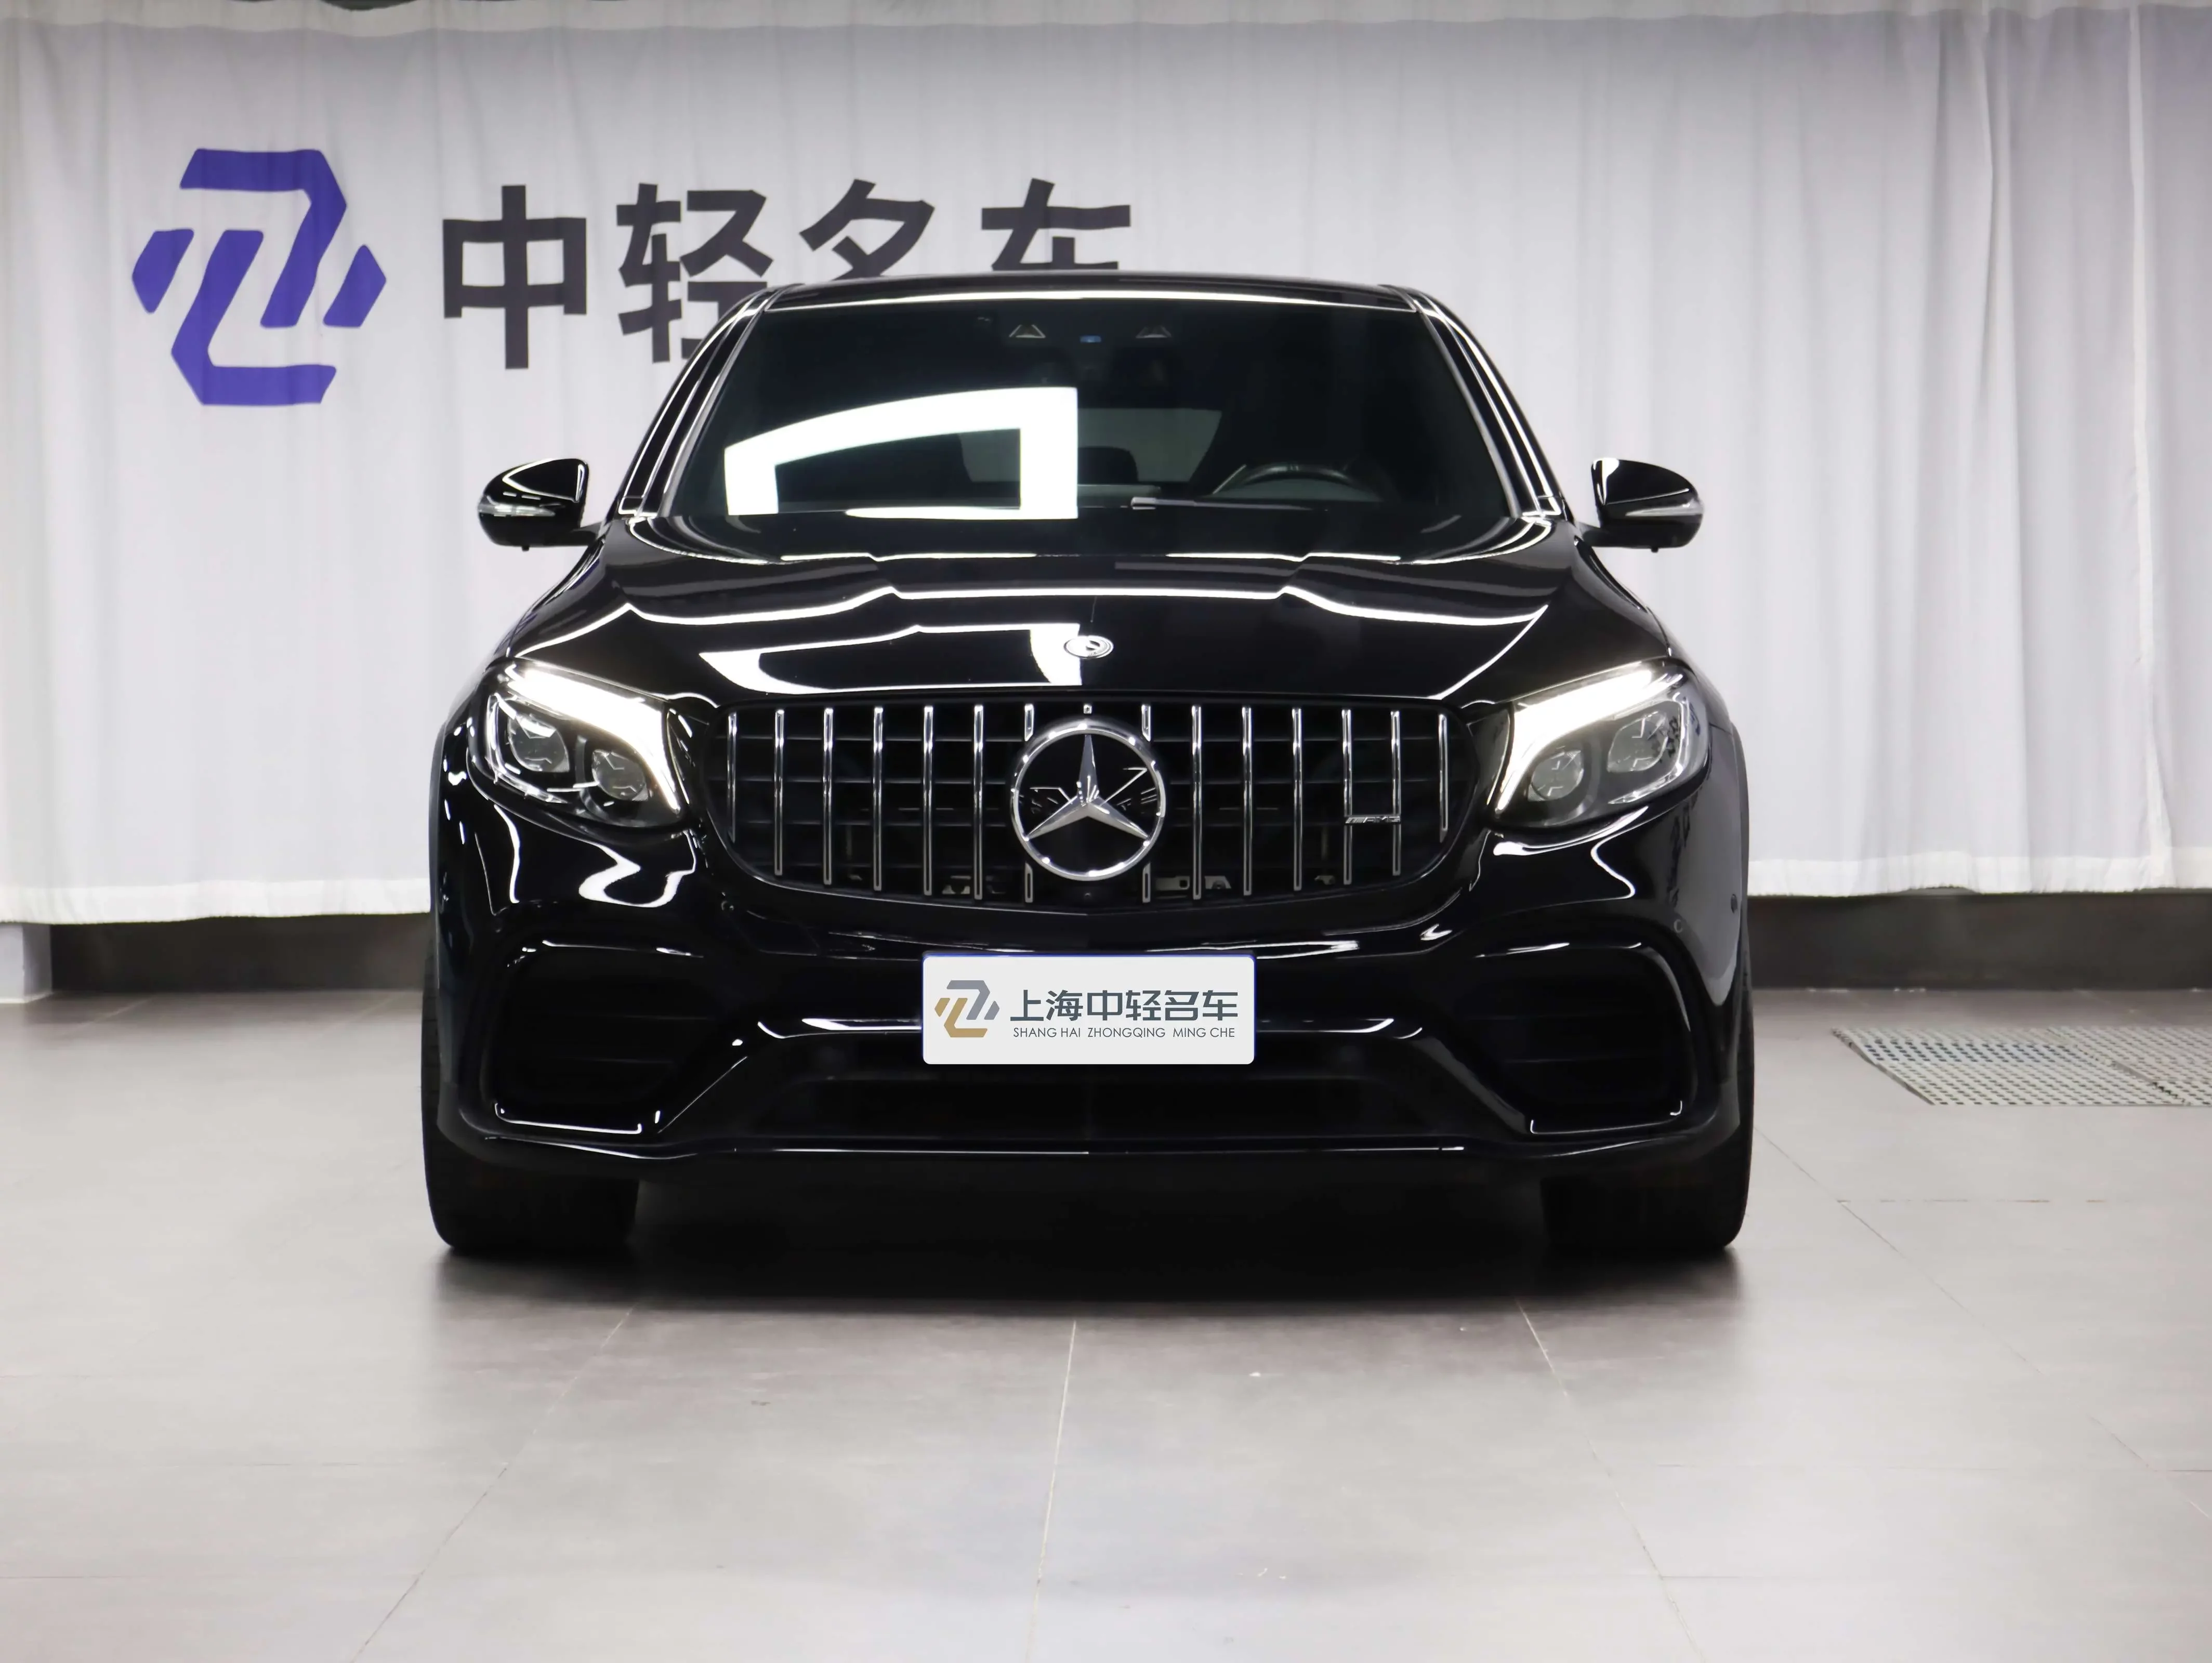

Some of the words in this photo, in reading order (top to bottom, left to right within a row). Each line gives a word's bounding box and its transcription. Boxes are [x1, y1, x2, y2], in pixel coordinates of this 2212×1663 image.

[1010, 989, 1237, 1021] 上海中轻名车
[1013, 1027, 1057, 1037] SHANG
[1061, 1027, 1080, 1037] HAI
[1088, 1027, 1165, 1038] ZHONGQING
[1173, 1027, 1206, 1037] MING
[1210, 1027, 1234, 1037] CHE
